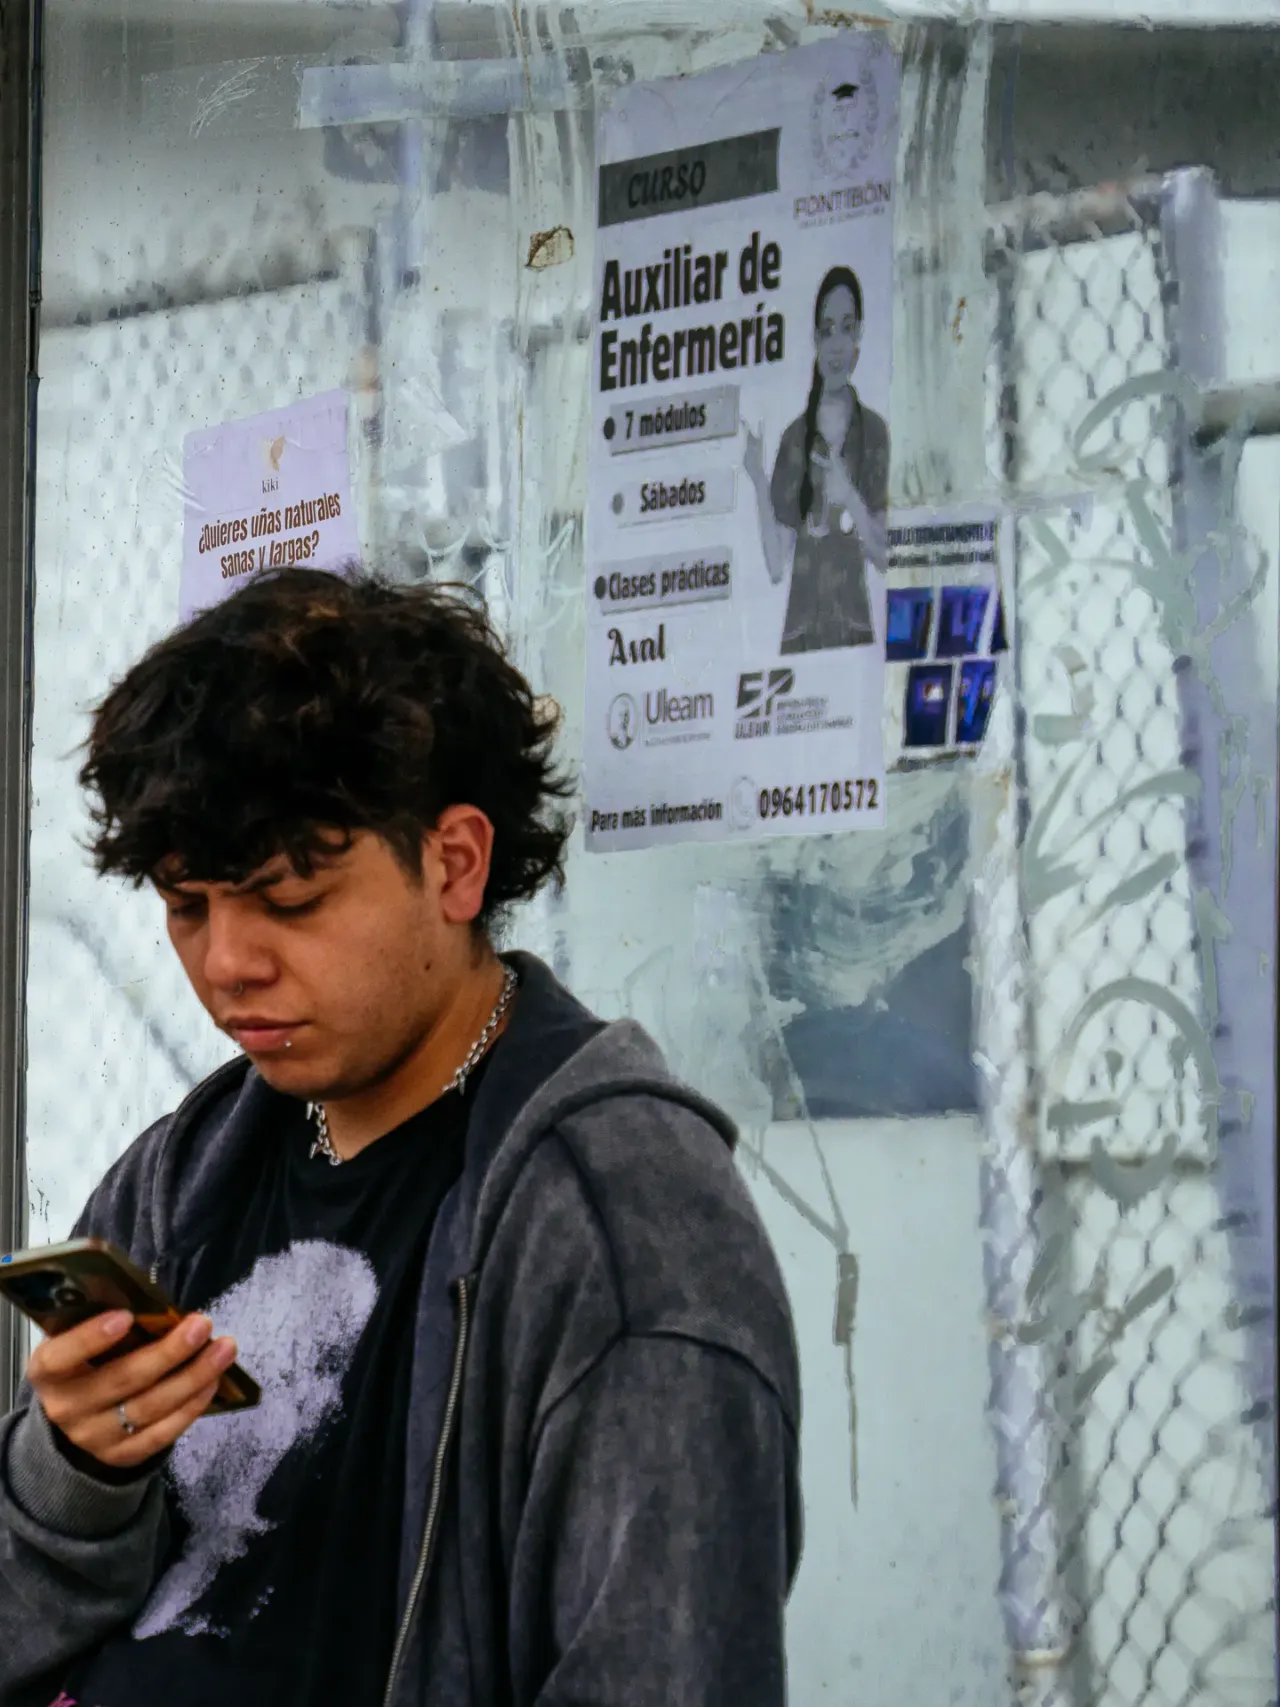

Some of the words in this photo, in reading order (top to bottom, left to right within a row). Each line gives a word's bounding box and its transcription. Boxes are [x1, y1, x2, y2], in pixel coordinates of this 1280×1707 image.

[627, 159, 707, 209] CURSO
[599, 244, 728, 323] Auxiliar
[739, 231, 781, 295] de
[599, 301, 784, 392] Enfermería
[625, 411, 634, 440] 7
[639, 401, 706, 437] módulos
[261, 477, 280, 494] kiki
[640, 477, 705, 513] Sábados
[198, 519, 248, 555] ¿Quieres
[251, 507, 281, 538] uñas
[284, 493, 341, 531] naturales
[220, 548, 255, 579] sanas
[258, 545, 266, 571] y
[269, 530, 320, 567] largas?
[608, 572, 656, 601] Clases
[661, 560, 730, 597] prácticas
[644, 687, 716, 727] Uleam
[590, 809, 619, 833] Para
[621, 809, 646, 829] más
[650, 802, 722, 826] información
[758, 778, 878, 819] 0964170572
